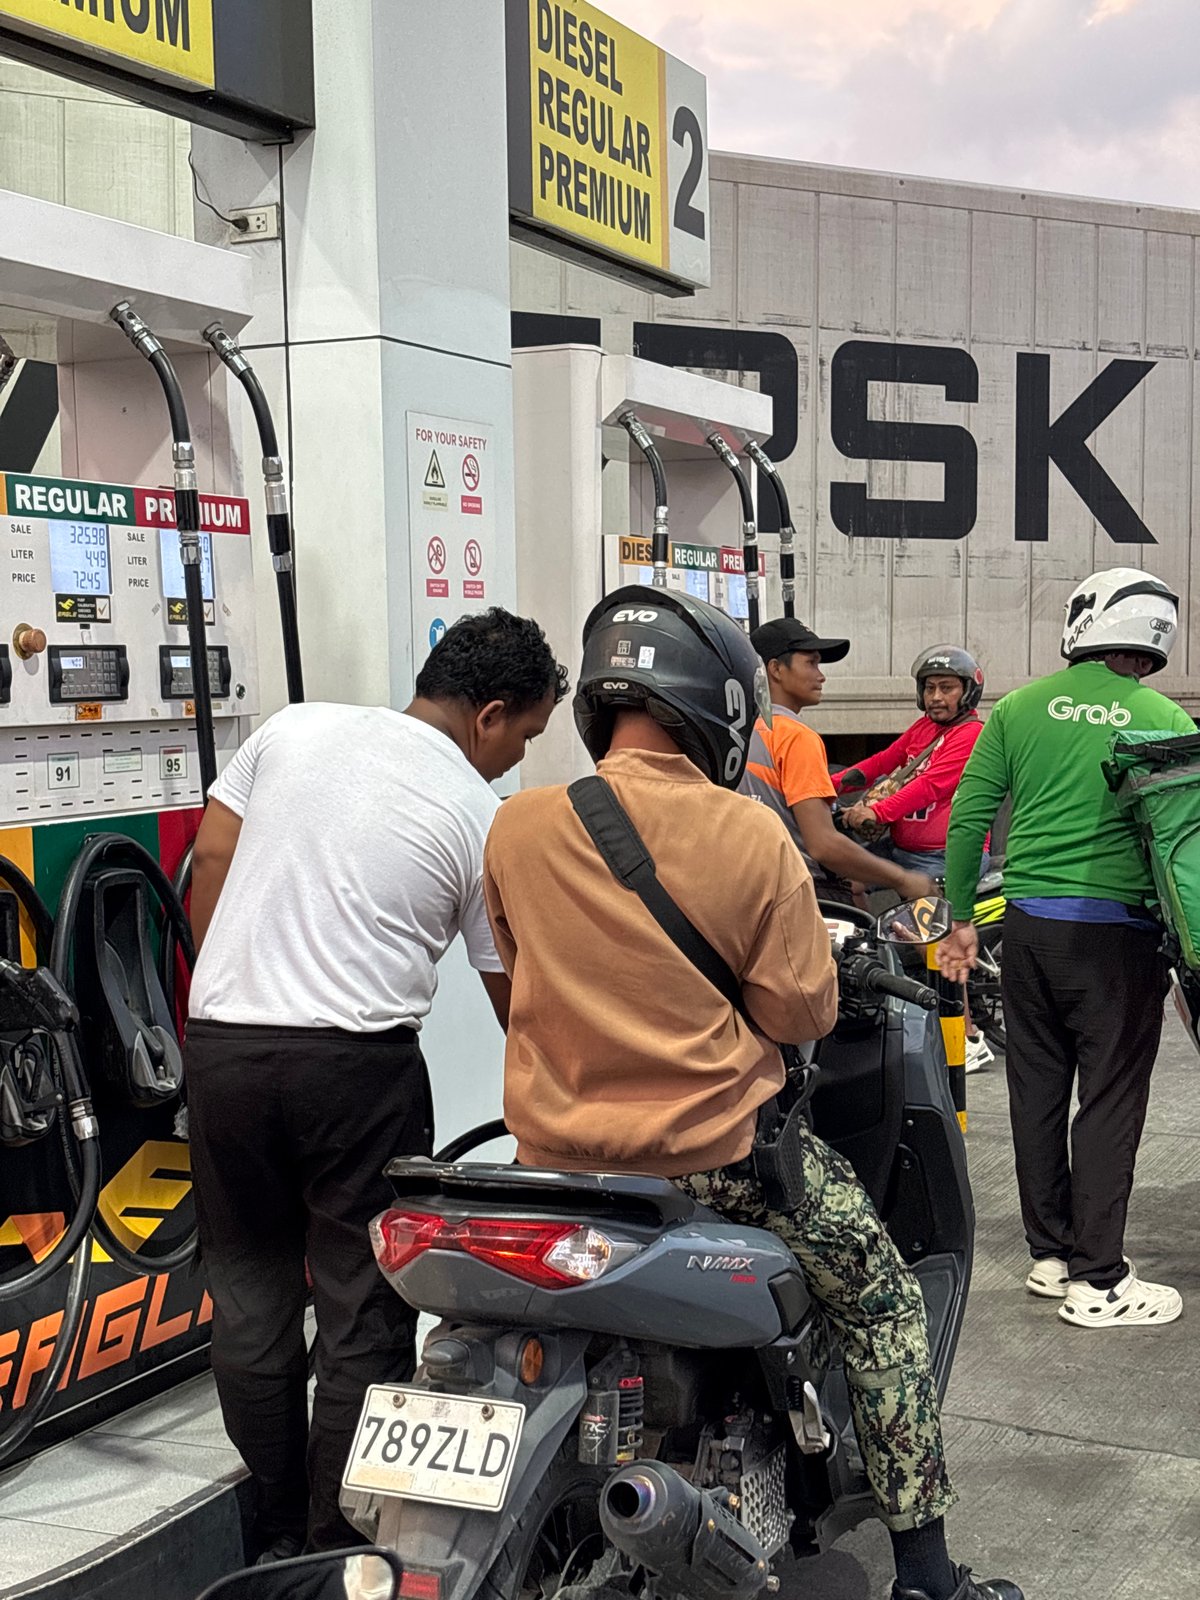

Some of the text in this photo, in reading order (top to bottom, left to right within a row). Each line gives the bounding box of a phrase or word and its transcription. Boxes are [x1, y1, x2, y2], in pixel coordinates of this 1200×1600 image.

[537, 0, 623, 96] DIESEL
[538, 67, 652, 178] REGULAR
[672, 105, 706, 241] 2
[539, 142, 651, 244] PREMIUM
[415, 428, 487, 451] FOR YOUR SAFETY
[15, 484, 242, 528] REGULAR PRIUM
[10, 523, 32, 534] SALE
[127, 532, 146, 543] SALE
[10, 549, 34, 560] LITER
[127, 556, 148, 566] LITER
[622, 541, 669, 563] DIES
[674, 547, 718, 568] REGULAR
[11, 573, 36, 583] PRICE
[128, 578, 150, 588] PRICE
[612, 609, 659, 623] EVO
[602, 681, 629, 690] EVO
[1047, 695, 1132, 727] Grab
[724, 678, 747, 781] EVO
[55, 766, 71, 782] 91
[166, 758, 180, 773] 95
[686, 1255, 755, 1272] NMAX
[360, 1416, 510, 1478] 789ZLD
